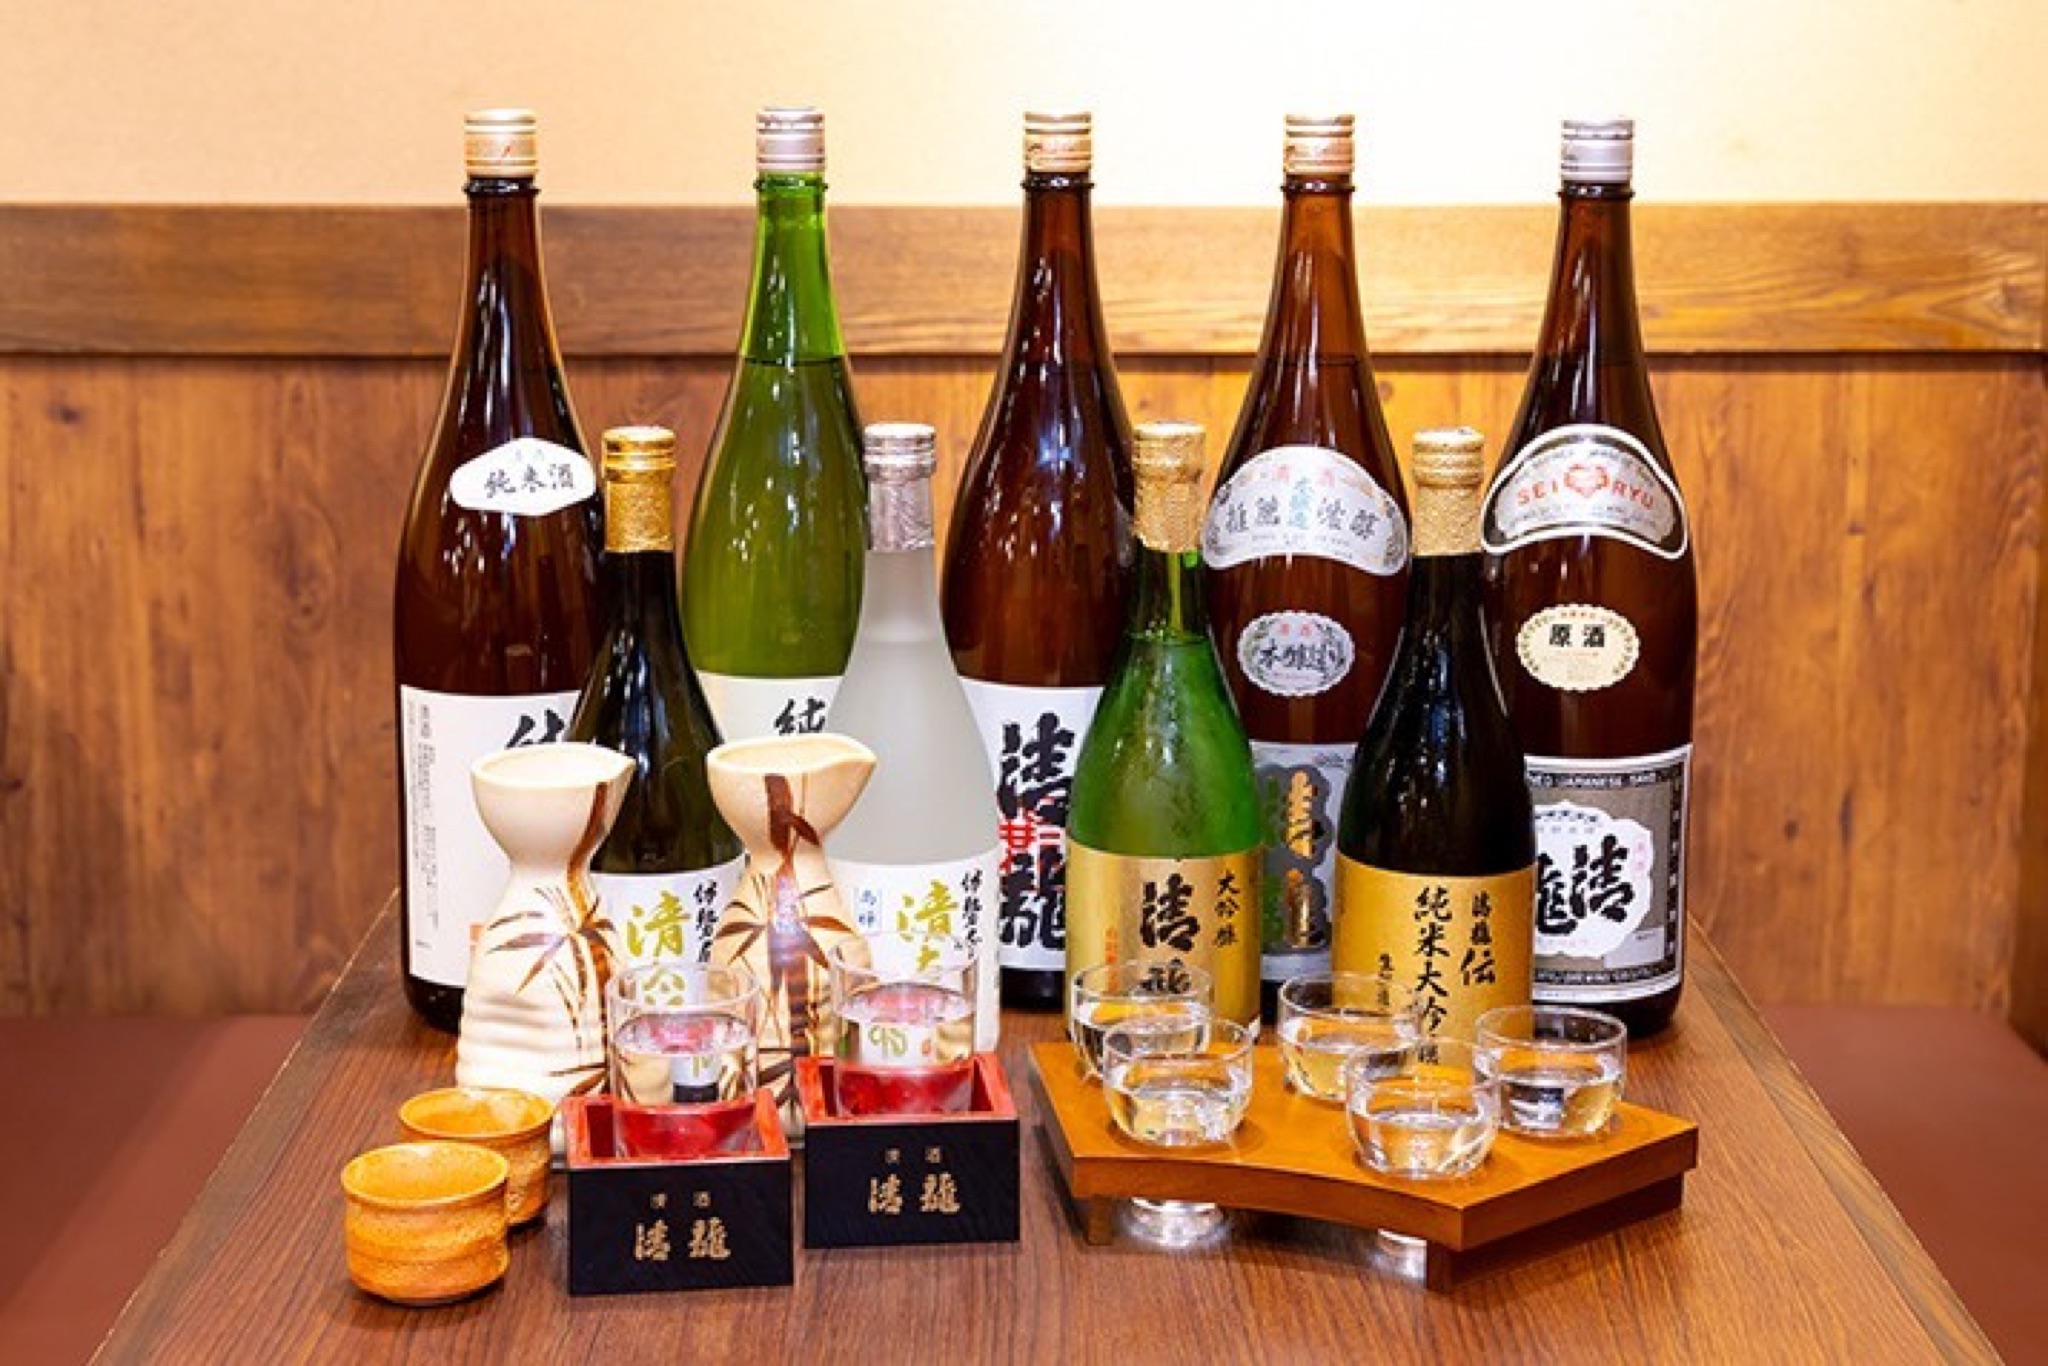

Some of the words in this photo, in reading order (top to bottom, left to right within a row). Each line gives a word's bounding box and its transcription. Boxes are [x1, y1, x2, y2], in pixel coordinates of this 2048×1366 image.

[484, 463, 573, 499] 純米酒
[1517, 481, 1559, 505] SEI
[1612, 479, 1654, 509] RYU
[1549, 623, 1605, 648] 原酒
